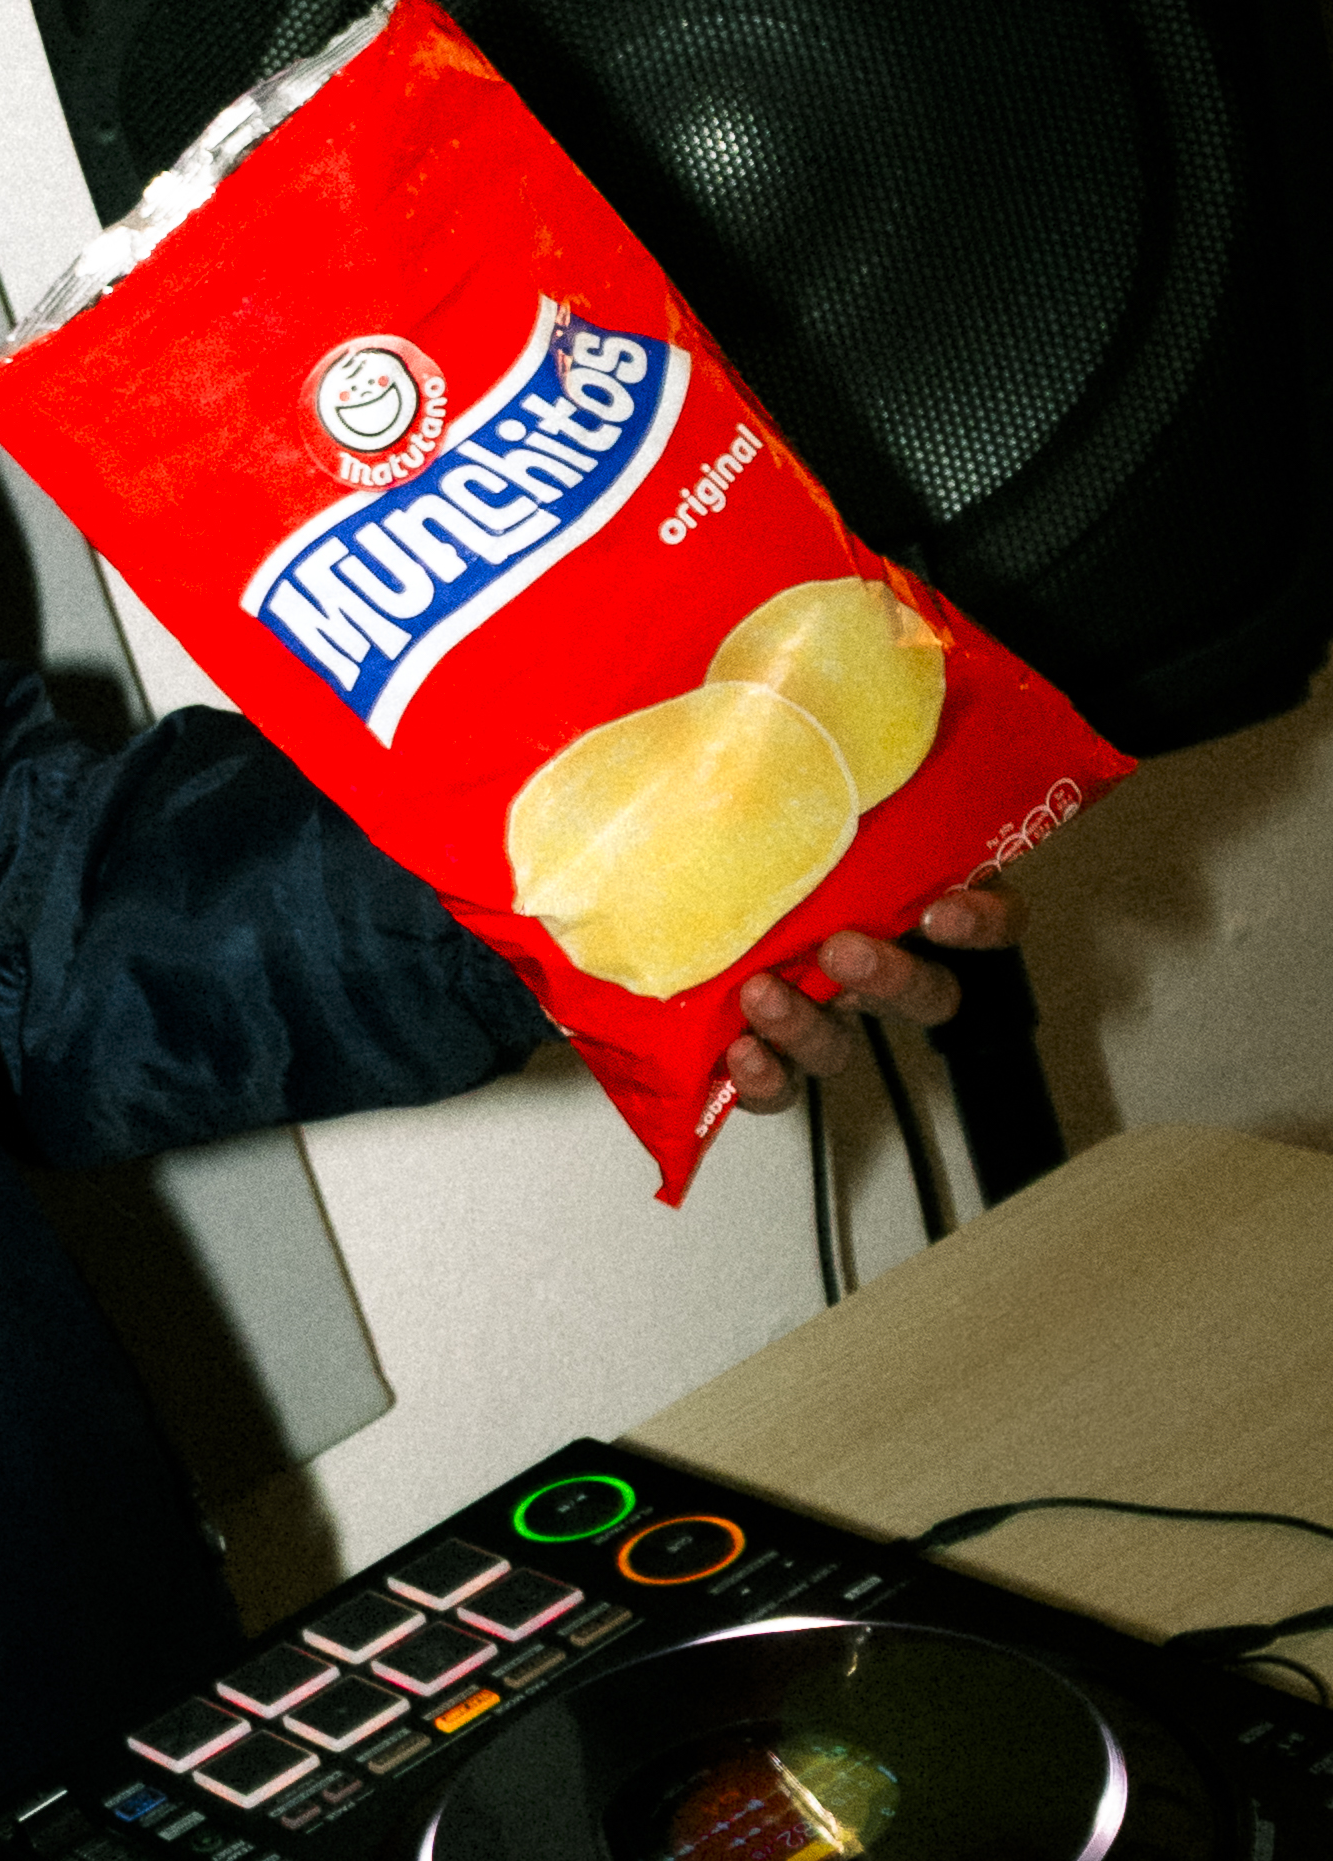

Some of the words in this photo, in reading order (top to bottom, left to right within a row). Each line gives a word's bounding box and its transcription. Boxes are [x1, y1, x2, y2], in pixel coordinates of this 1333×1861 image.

[337, 374, 448, 487] Matutano
[658, 422, 764, 546] original
[266, 330, 649, 692] Munchitos
